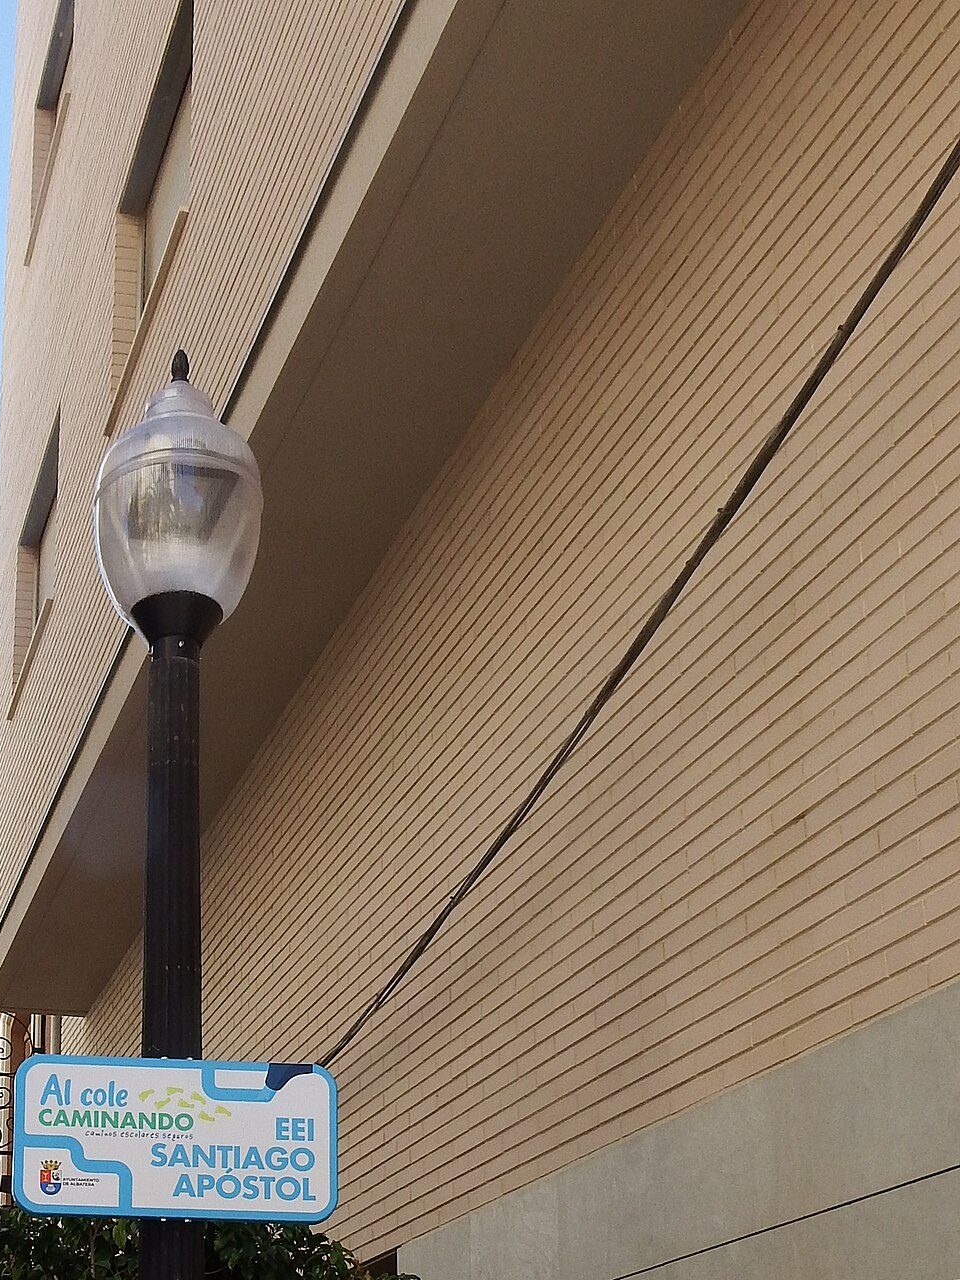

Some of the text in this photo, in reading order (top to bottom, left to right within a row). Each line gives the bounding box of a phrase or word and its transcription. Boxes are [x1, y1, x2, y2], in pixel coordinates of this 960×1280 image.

[40, 1073, 129, 1107] Al cole
[38, 1108, 194, 1131] CAMINANDO
[275, 1117, 315, 1142] EEI
[85, 1130, 194, 1141] caminos escolares seguros
[150, 1143, 316, 1172] SANTIAGO
[172, 1168, 317, 1202] APÓSTOL
